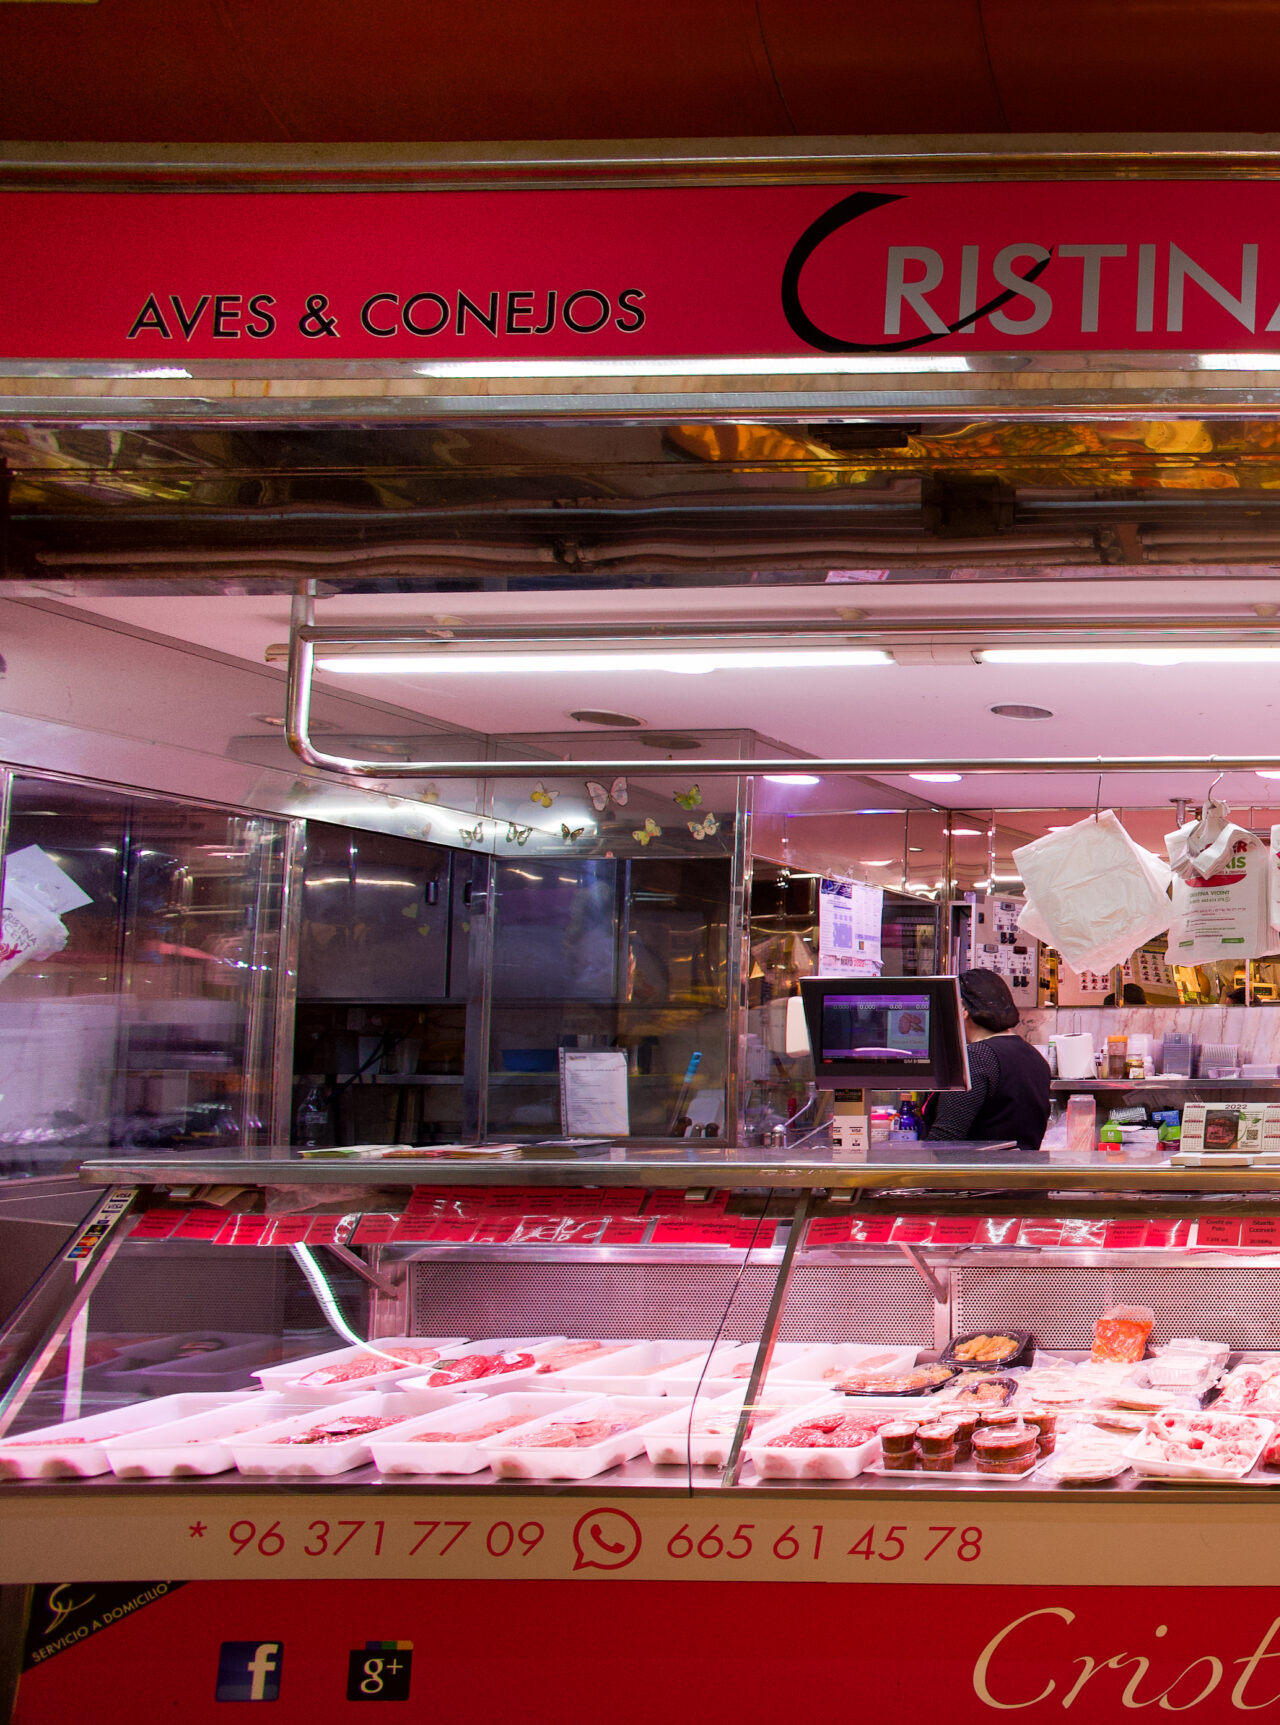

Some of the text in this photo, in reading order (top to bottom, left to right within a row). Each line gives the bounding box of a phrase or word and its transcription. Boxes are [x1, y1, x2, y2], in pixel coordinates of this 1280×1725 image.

[127, 289, 646, 342] AVES & CONEJOS
[1226, 856, 1246, 869] IS
[228, 1520, 286, 1556] 96
[304, 1520, 387, 1556] 371
[407, 1520, 472, 1556] 77
[485, 1520, 546, 1557] 09
[666, 1523, 756, 1560] 665
[772, 1524, 826, 1561] 61
[847, 1525, 908, 1562] 45
[922, 1525, 983, 1563] 78
[32, 1626, 89, 1662] SERVICIO
[92, 1619, 102, 1631] A
